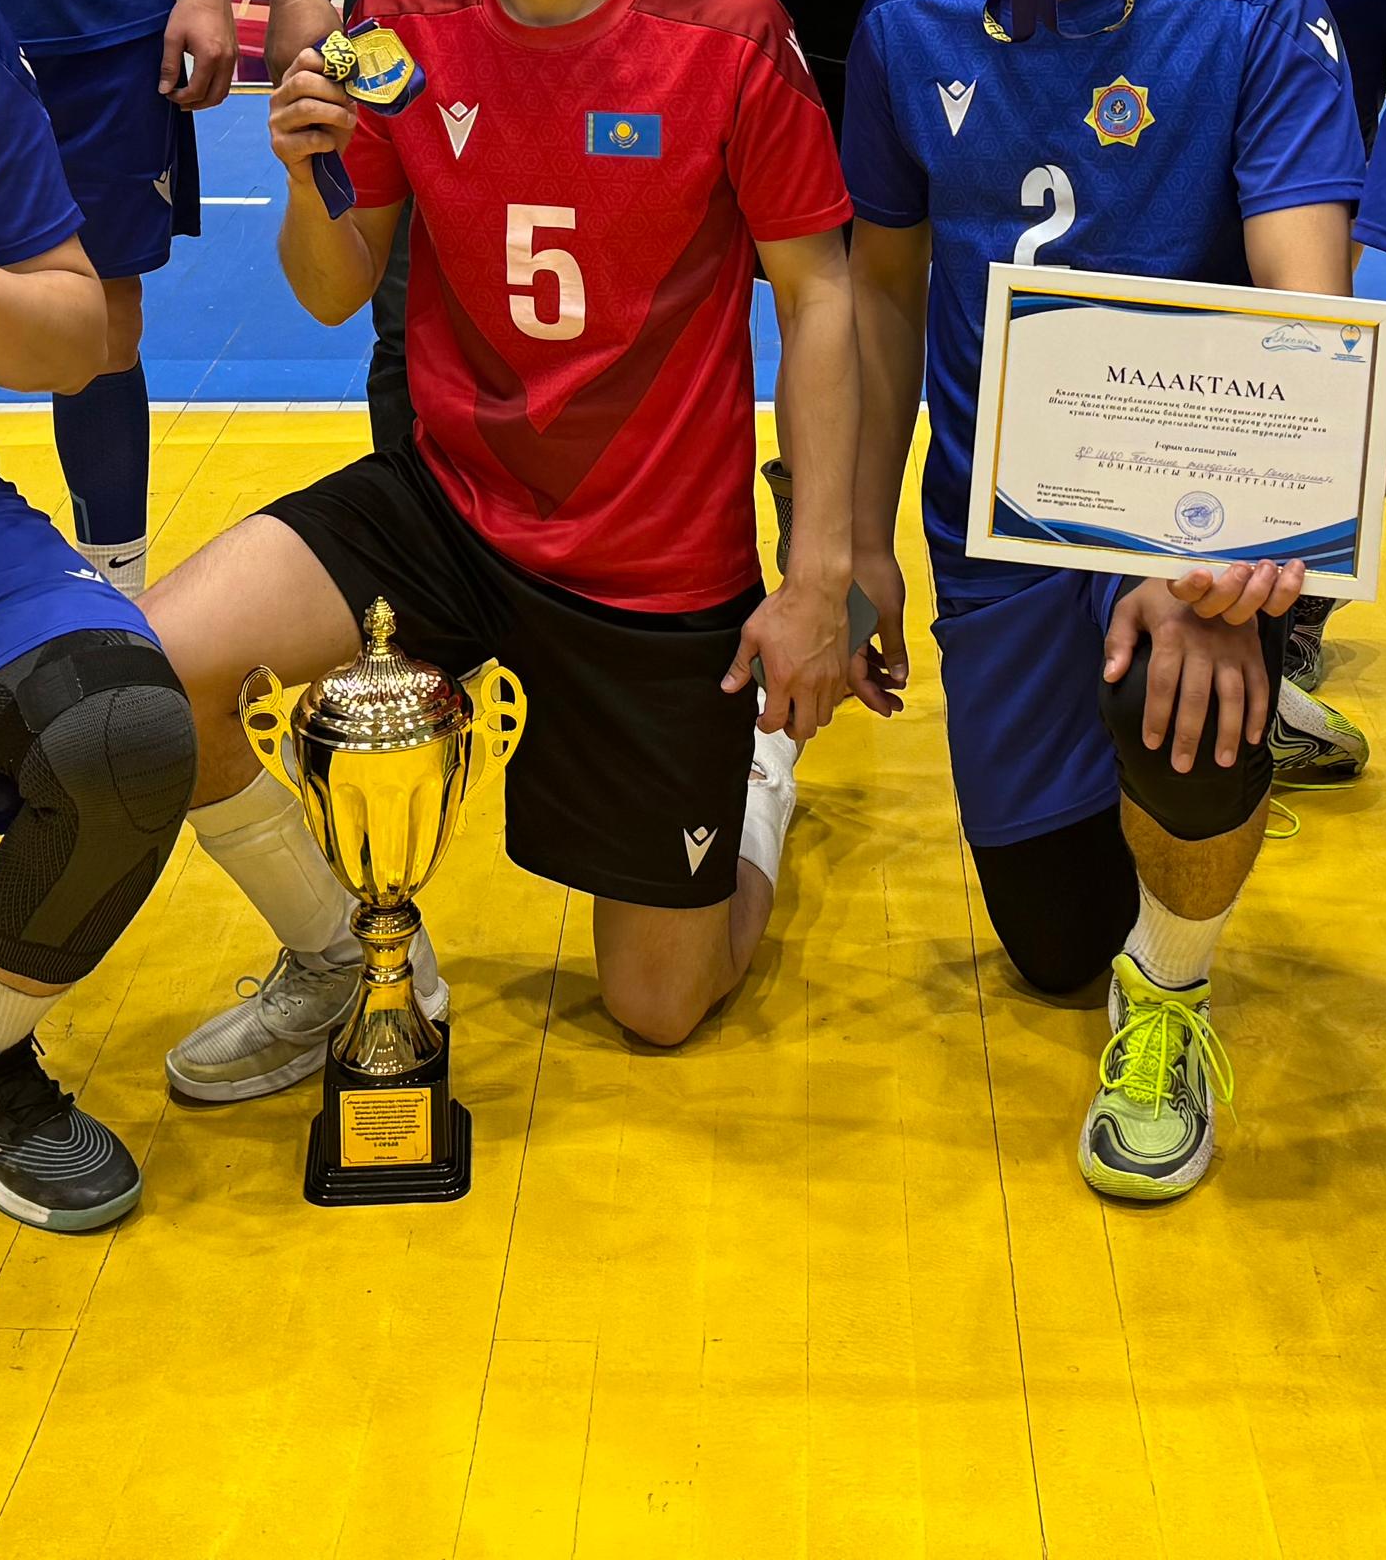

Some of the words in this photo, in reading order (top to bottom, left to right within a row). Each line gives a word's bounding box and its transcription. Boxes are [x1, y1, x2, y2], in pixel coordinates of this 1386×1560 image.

[1014, 164, 1076, 269] 2
[506, 203, 586, 341] 5
[1106, 364, 1286, 402] МАДАҚТАМА
